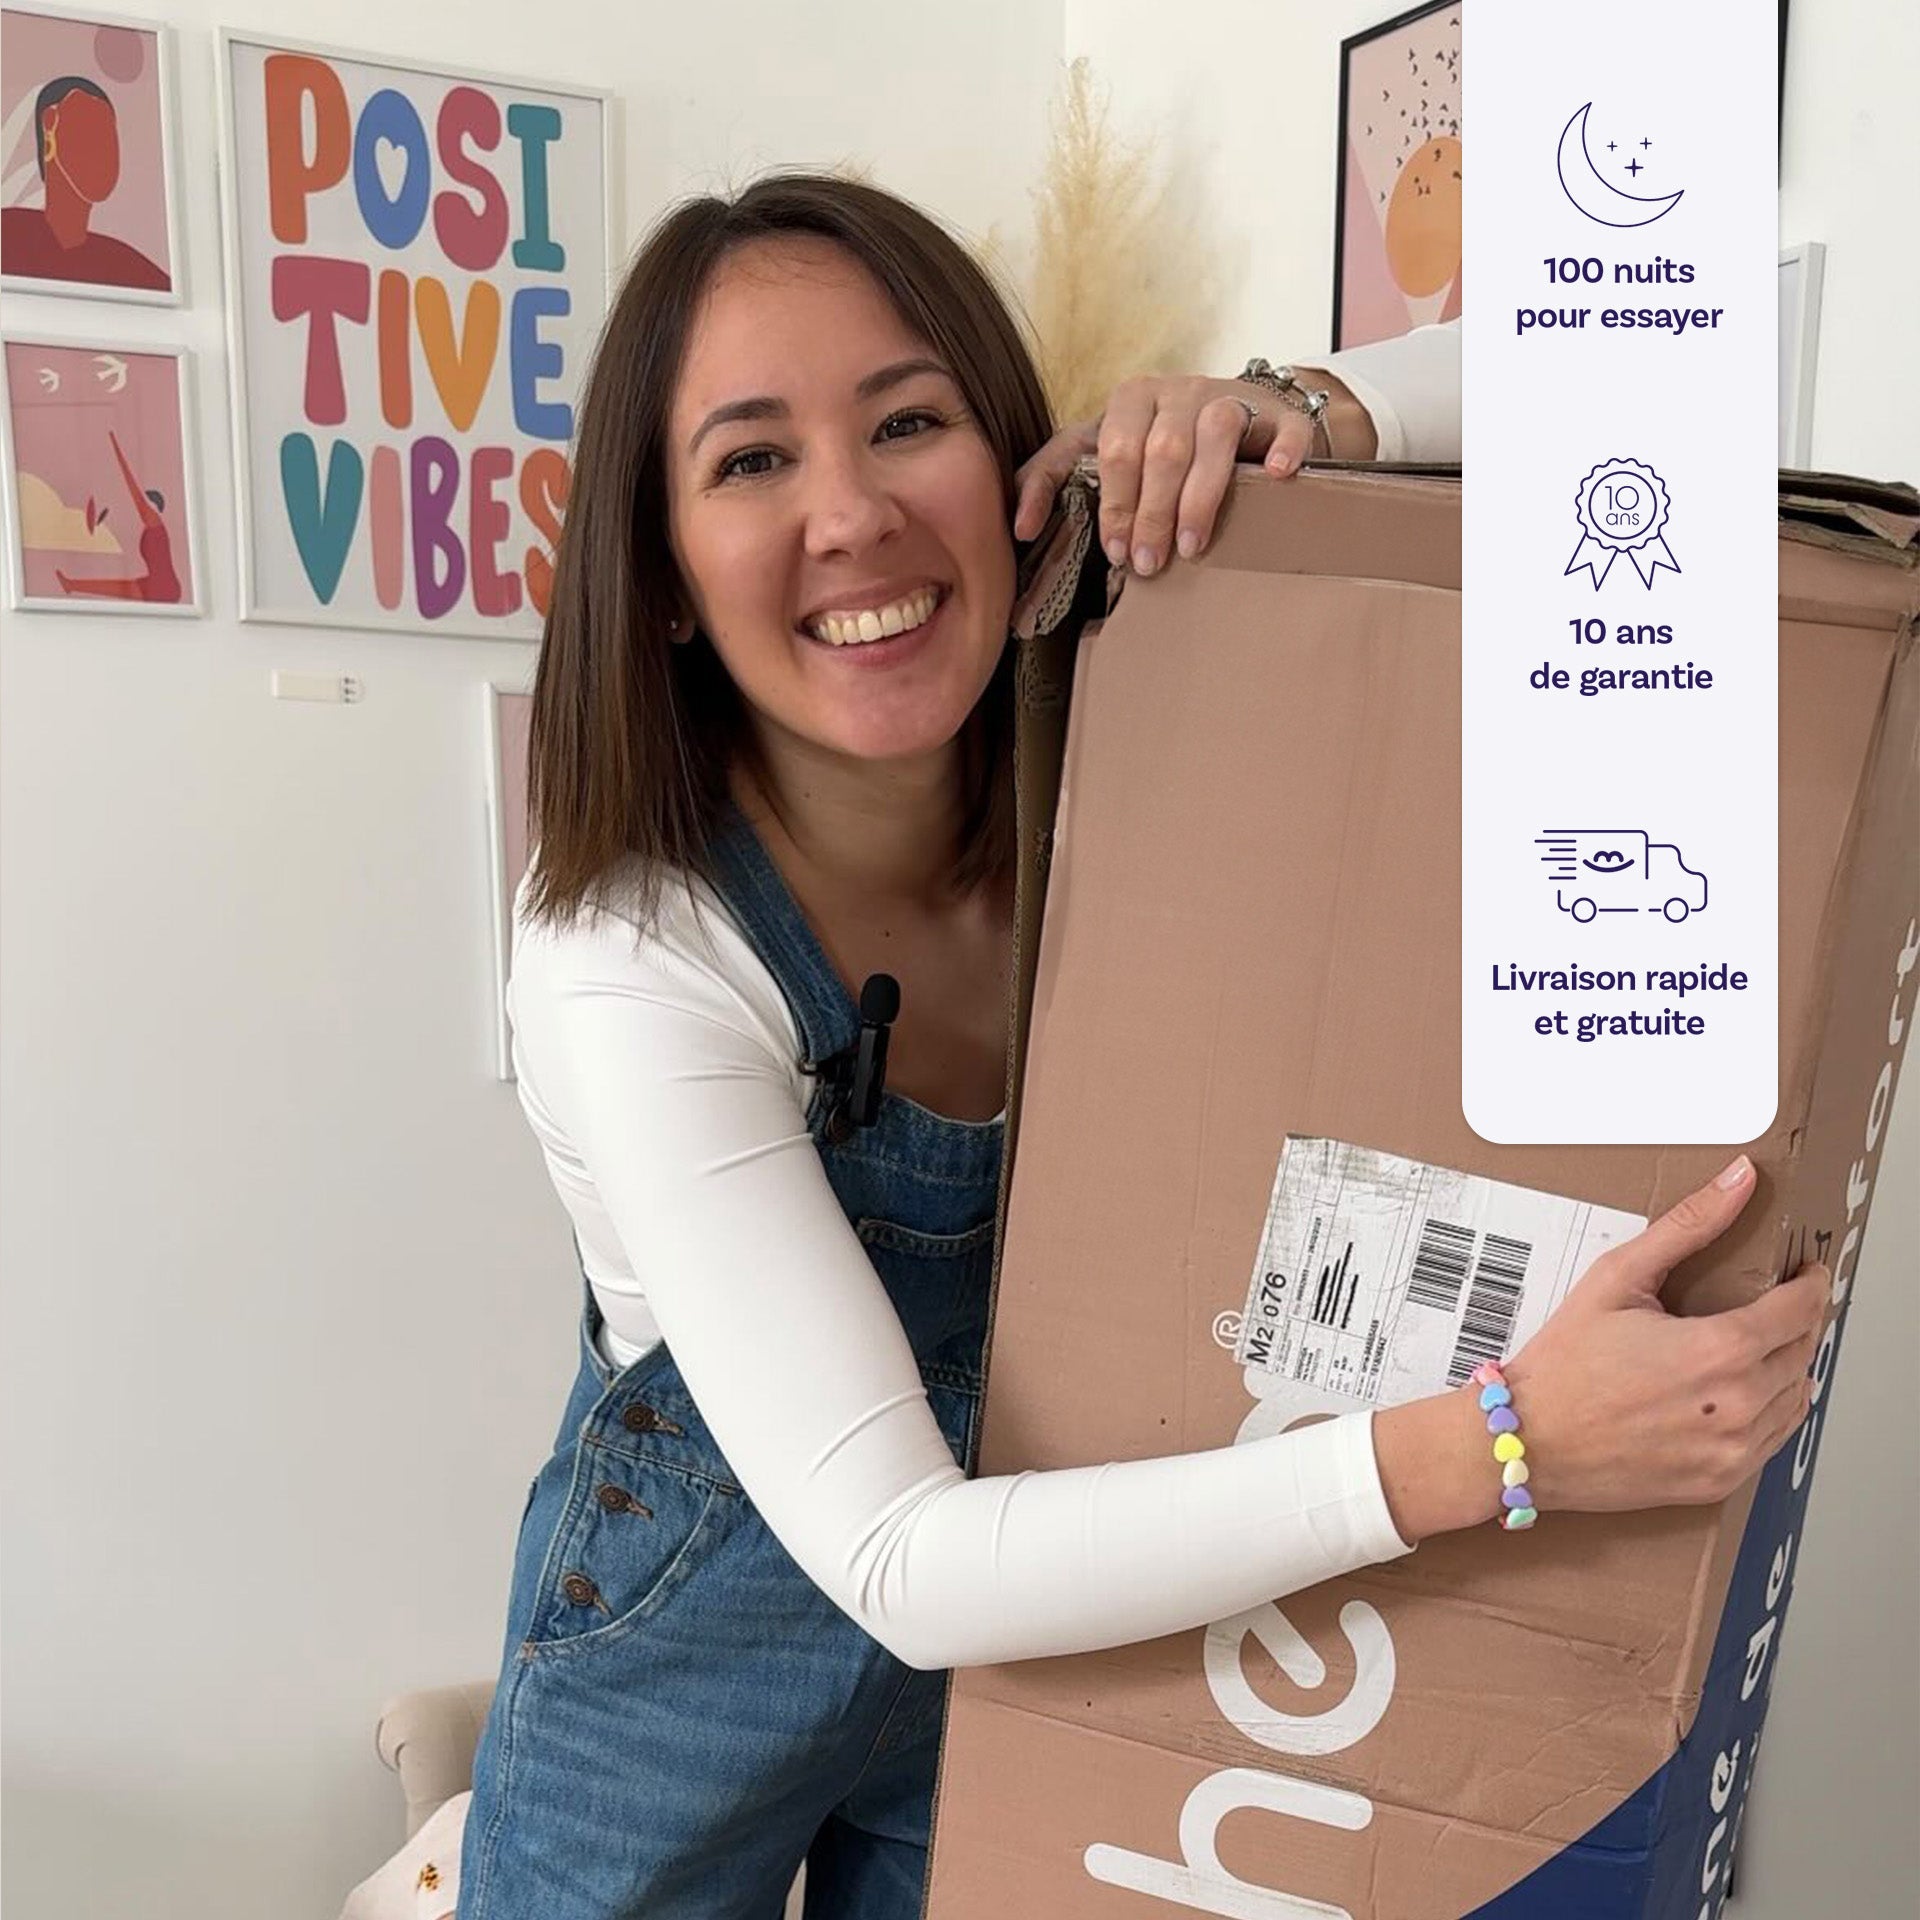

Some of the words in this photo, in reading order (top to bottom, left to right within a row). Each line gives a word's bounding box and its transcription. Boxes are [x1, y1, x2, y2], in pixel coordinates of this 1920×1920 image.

[265, 54, 565, 272] POSI
[271, 255, 573, 440] TIVE
[281, 432, 573, 619] VIBES
[1246, 1326, 1275, 1365] M2
[1261, 1271, 1287, 1318] 076
[1697, 1739, 1740, 1920] ne
[1741, 1532, 1792, 1700] de
